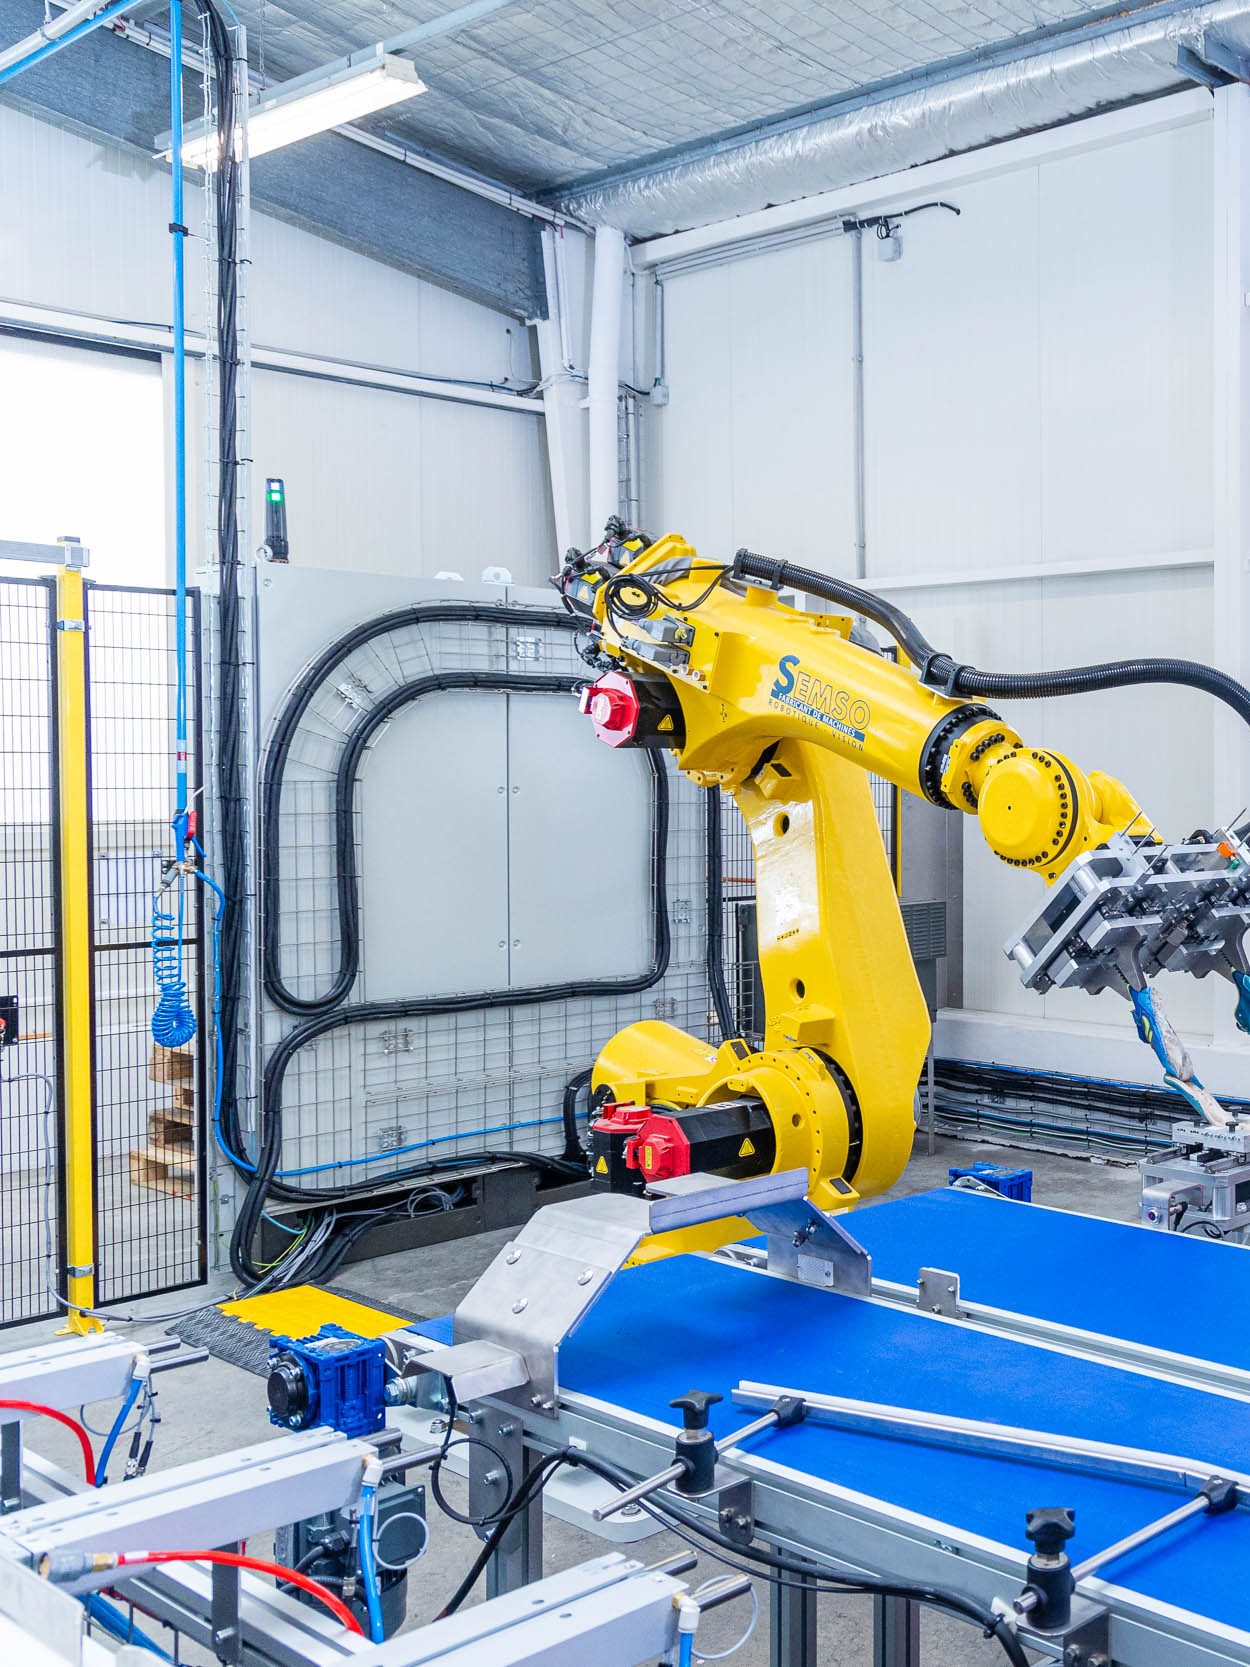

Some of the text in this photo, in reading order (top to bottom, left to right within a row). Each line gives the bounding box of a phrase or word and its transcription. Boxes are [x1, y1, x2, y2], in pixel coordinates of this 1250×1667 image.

[768, 698, 819, 729] ROBOTIQUE
[771, 654, 871, 731] SEMSO
[778, 692, 856, 737] FABRICANT DE MACHINES
